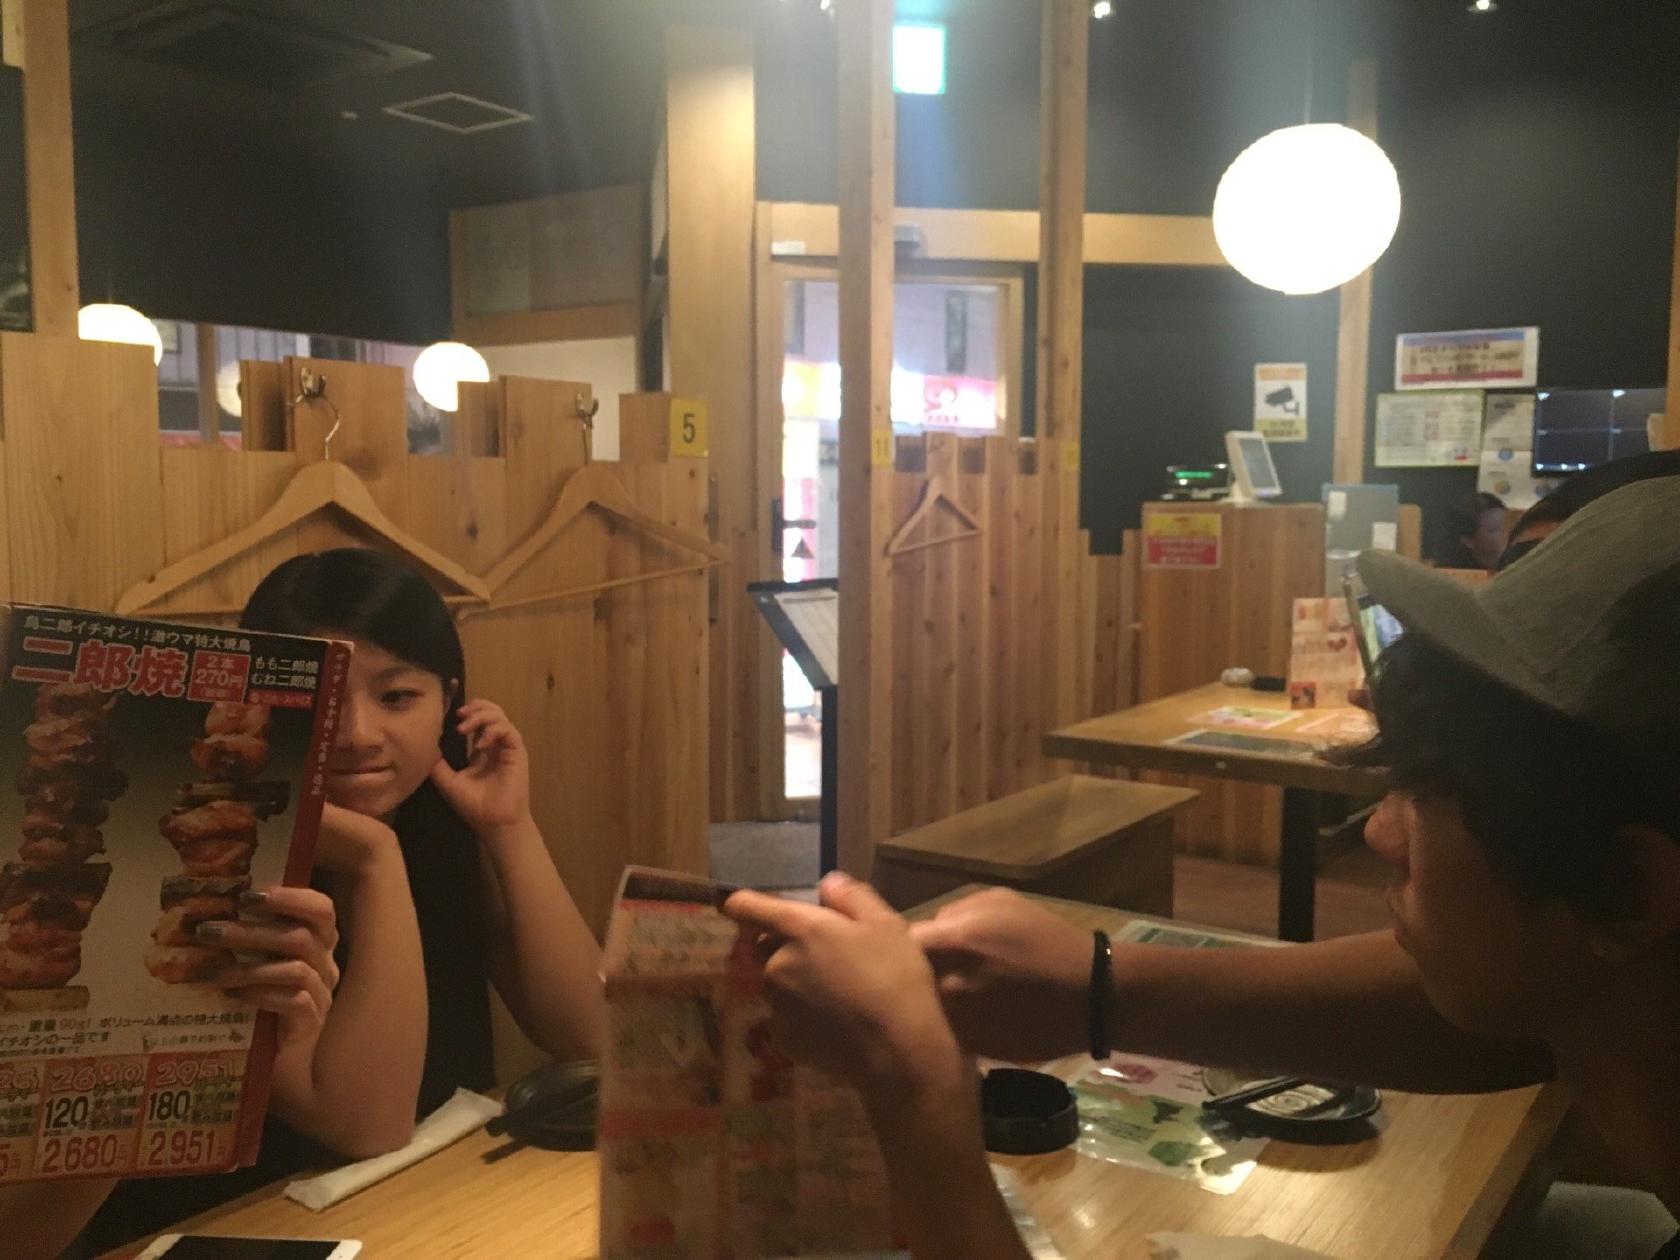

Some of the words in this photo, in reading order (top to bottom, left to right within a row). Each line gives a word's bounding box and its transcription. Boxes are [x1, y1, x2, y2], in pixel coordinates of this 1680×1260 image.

[683, 413, 696, 444] 5
[12, 638, 190, 698] 二郎焼
[206, 656, 236, 670] 2本
[254, 655, 320, 674] もも二郎焼
[194, 668, 244, 689] 270円
[250, 672, 318, 690] むね二郎焼
